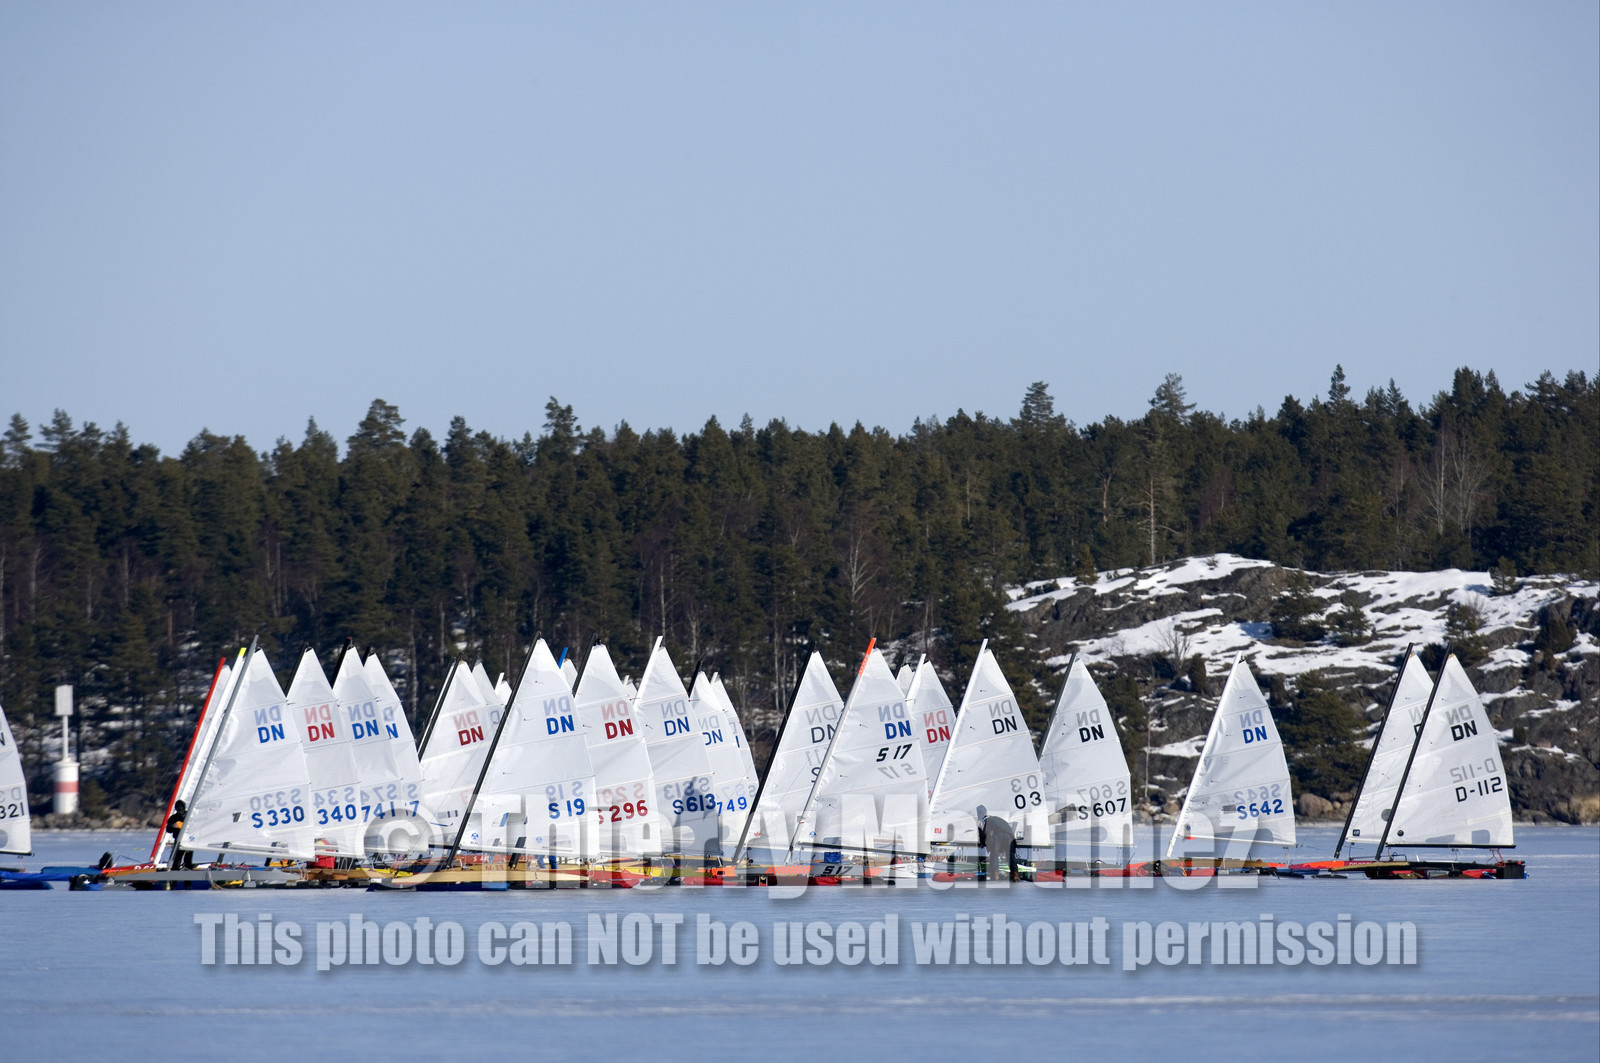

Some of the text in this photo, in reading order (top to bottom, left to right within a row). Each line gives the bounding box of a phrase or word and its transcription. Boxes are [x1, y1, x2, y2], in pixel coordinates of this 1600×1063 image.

[258, 723, 285, 743] DN
[307, 721, 335, 742] DN
[352, 719, 380, 739] DN
[545, 714, 574, 735] DN
[604, 718, 633, 739] DN
[664, 716, 691, 736] DN
[884, 719, 912, 740] DN
[926, 725, 951, 744] DN
[991, 715, 1018, 735] DN
[1078, 724, 1105, 743] DN
[1243, 725, 1268, 744] DN
[1451, 720, 1478, 741] DN
[458, 725, 484, 746] DN
[1456, 776, 1503, 803] D-112
[317, 803, 357, 825] 340
[672, 793, 717, 815] S613
[716, 796, 748, 816] 749
[1236, 799, 1284, 820] S642
